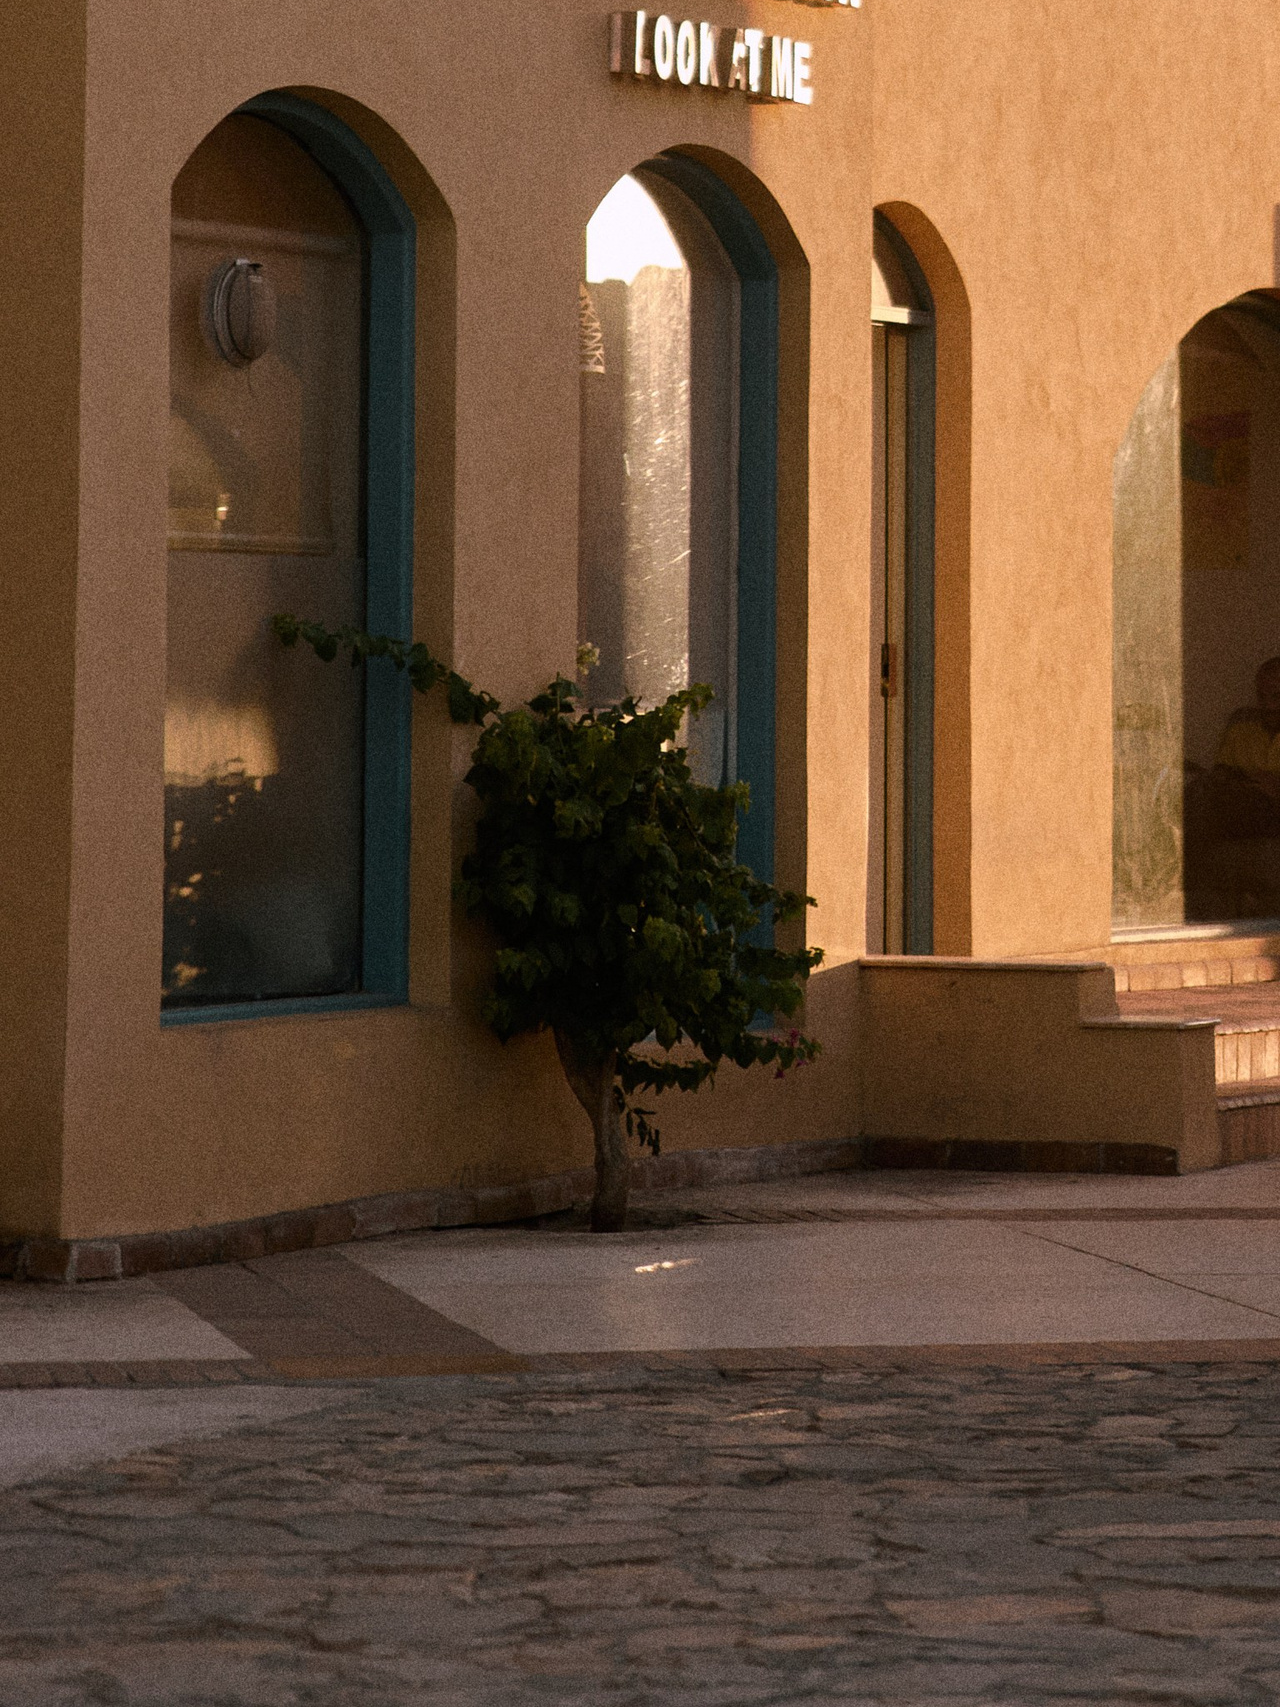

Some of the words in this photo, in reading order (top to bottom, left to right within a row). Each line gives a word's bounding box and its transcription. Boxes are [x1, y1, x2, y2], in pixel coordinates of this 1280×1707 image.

[634, 10, 720, 87] LOOK
[728, 27, 764, 93] AT
[770, 35, 813, 106] ME
